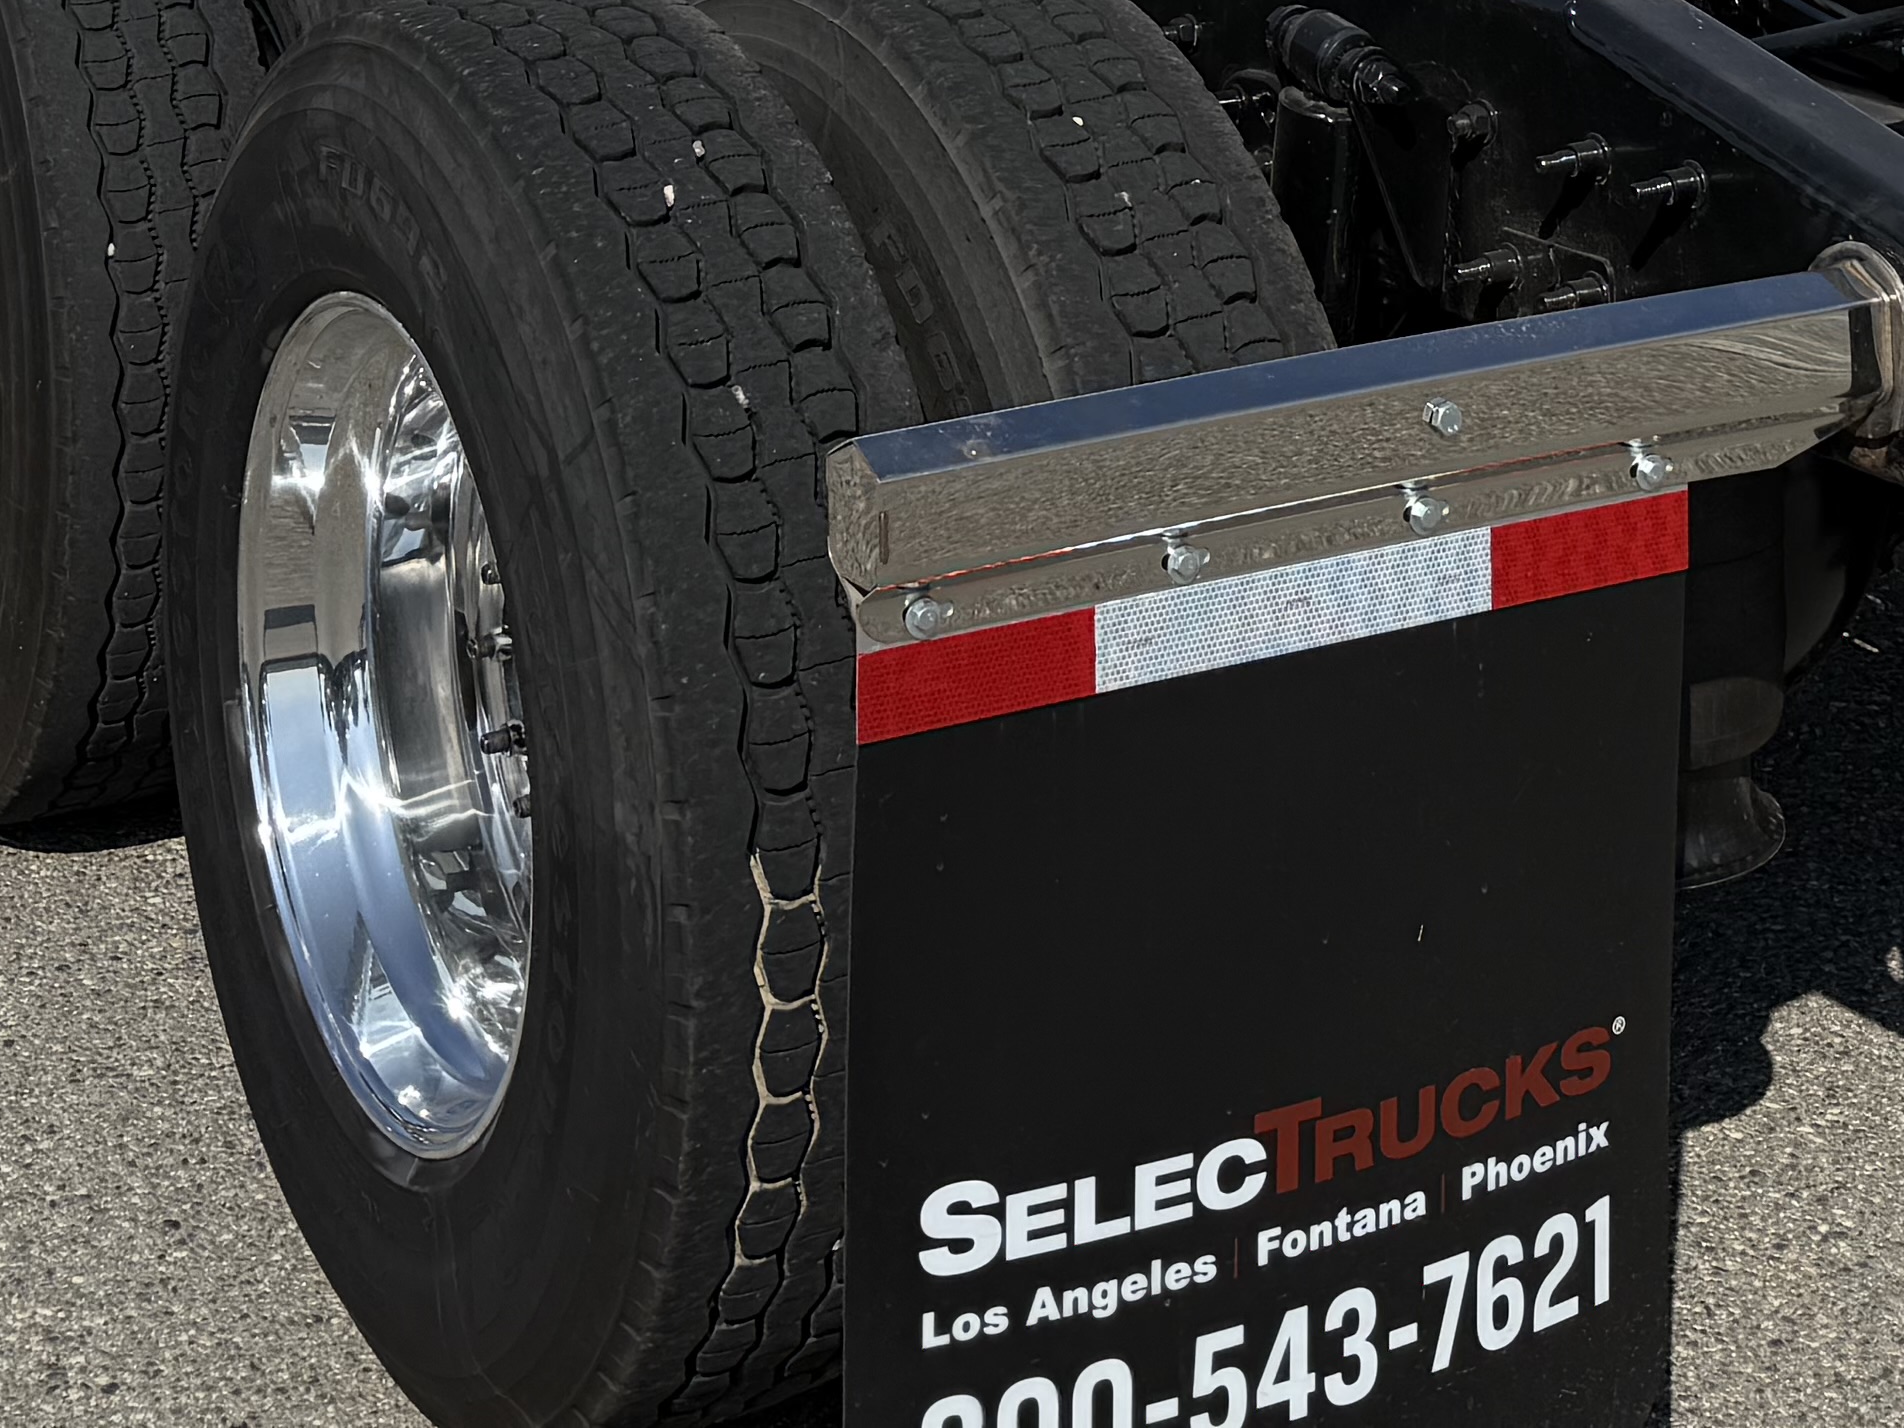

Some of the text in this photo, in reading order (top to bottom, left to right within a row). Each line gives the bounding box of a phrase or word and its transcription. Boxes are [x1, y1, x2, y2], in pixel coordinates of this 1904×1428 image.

[920, 1194, 1611, 1428] 0-543-7621
[921, 1119, 1610, 1350] Los Angeles Fontana Phoenix
